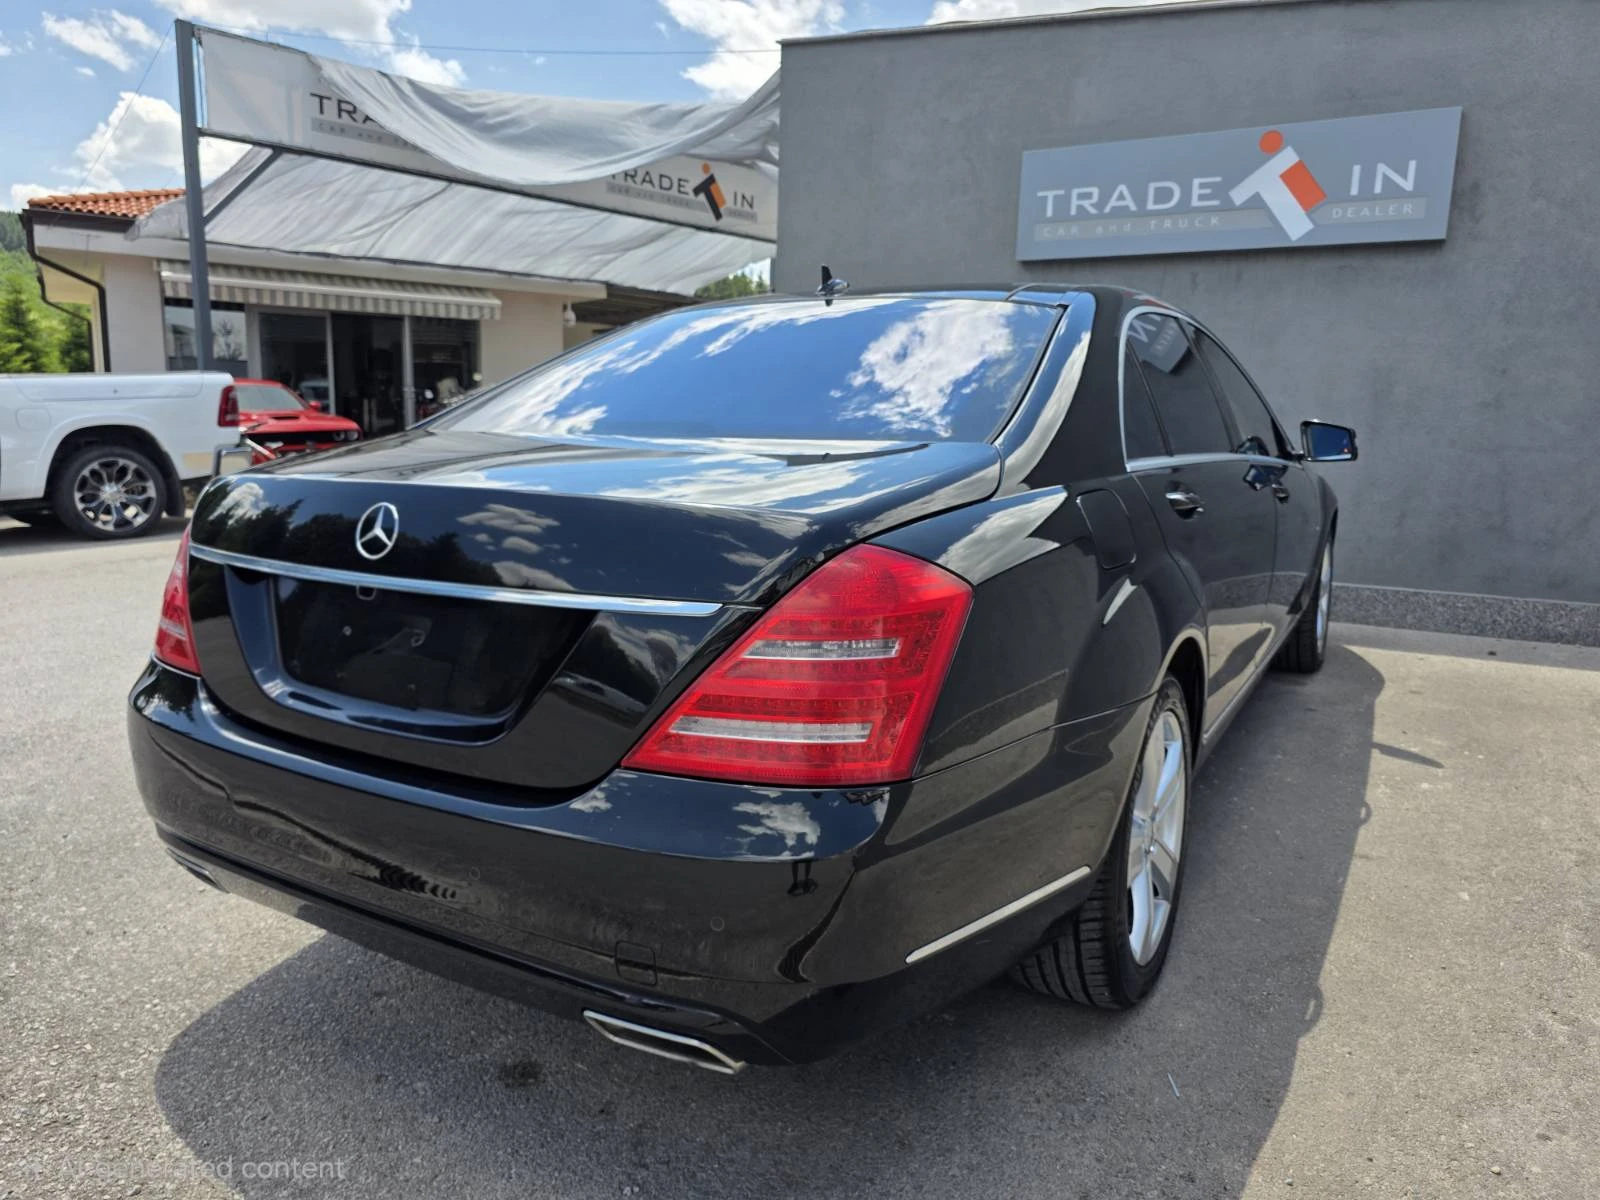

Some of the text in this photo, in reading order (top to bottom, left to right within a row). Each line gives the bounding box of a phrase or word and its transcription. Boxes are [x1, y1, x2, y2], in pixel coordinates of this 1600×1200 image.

[612, 169, 689, 195] RADE
[733, 191, 754, 210] IN
[1036, 177, 1223, 218] TRADE
[1350, 160, 1417, 196] IN
[1042, 223, 1080, 238] CAR
[1149, 215, 1221, 231] TRUCK
[1331, 202, 1415, 219] DEALER
